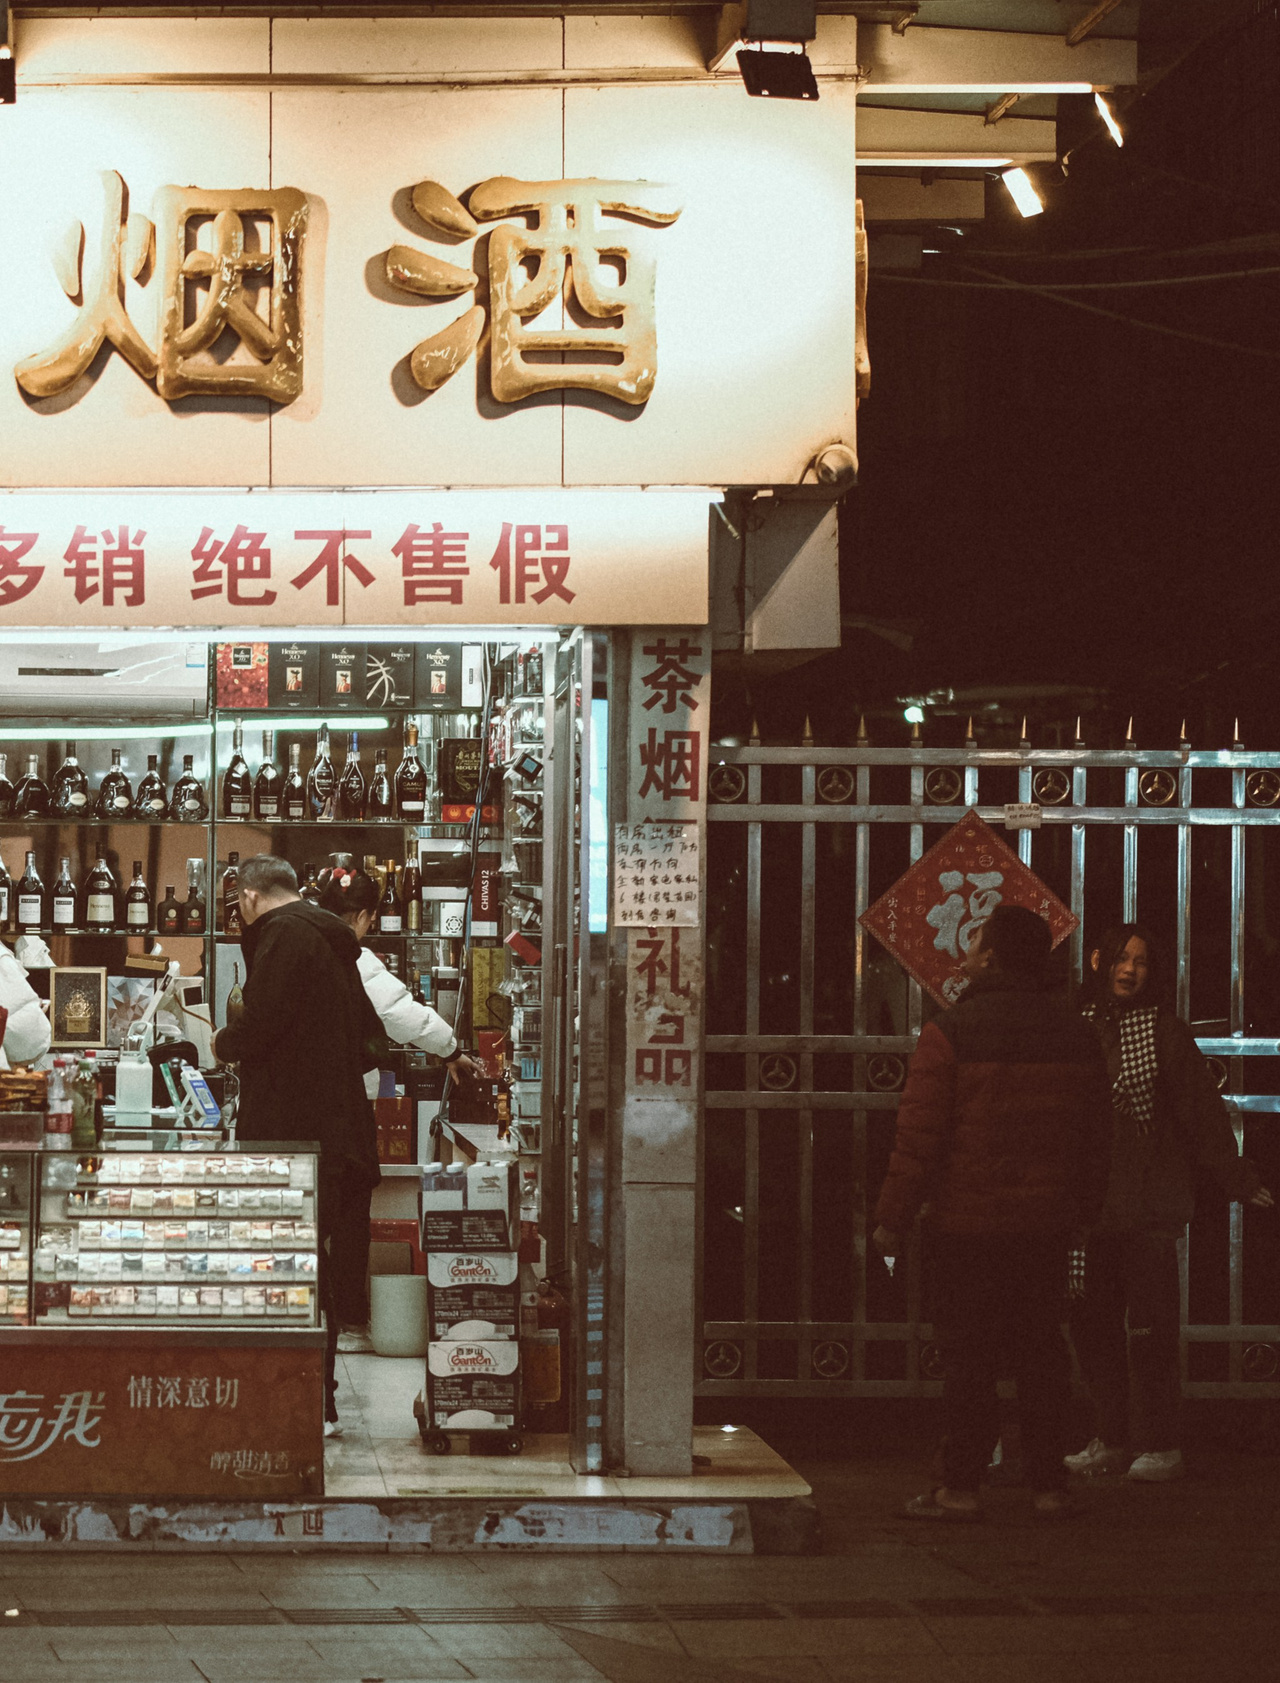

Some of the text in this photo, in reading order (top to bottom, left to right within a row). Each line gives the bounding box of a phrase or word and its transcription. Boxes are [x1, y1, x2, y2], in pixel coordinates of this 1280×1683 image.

[190, 521, 578, 606] 绝不售假
[480, 880, 490, 911] CHIVAS
[127, 1375, 239, 1409] 情深意切
